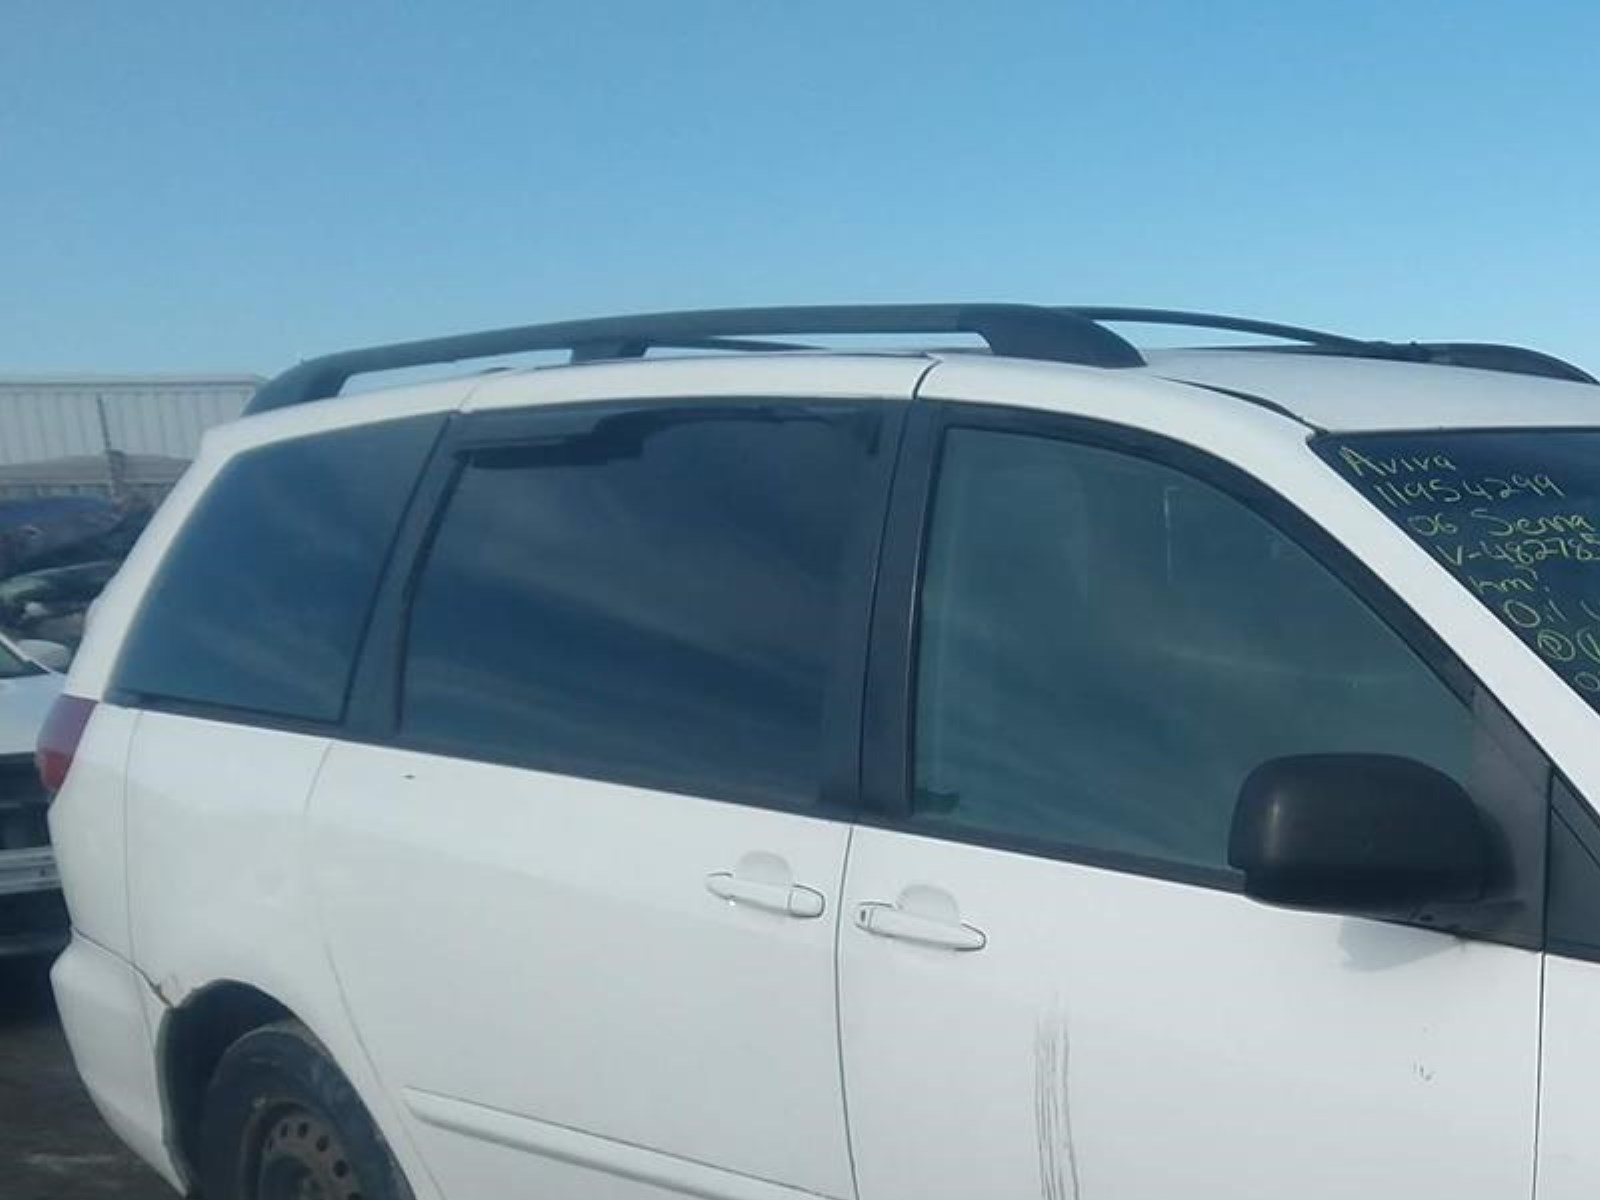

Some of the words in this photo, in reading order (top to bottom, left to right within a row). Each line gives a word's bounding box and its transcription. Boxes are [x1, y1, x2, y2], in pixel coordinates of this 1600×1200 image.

[1338, 445, 1457, 477] Aviva
[1373, 473, 1566, 507] 11954299
[1407, 512, 1459, 537] 06
